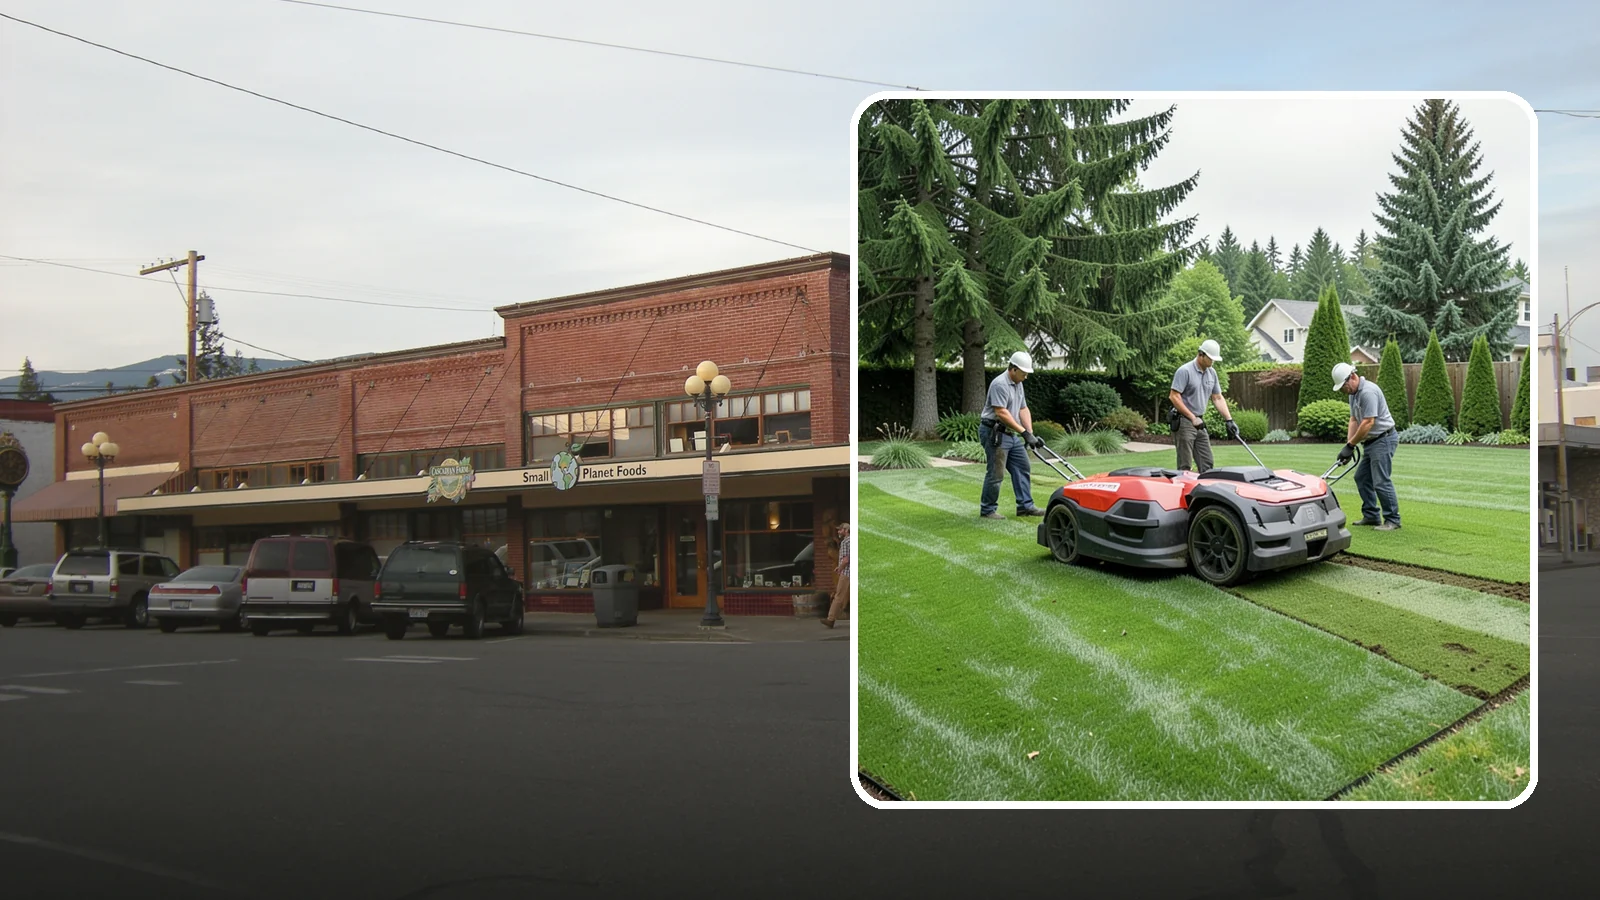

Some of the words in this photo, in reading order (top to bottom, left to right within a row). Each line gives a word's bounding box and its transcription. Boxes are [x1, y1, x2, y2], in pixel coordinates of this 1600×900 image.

[523, 470, 549, 483] Small
[582, 467, 614, 480] Planet
[617, 464, 647, 477] Foods
